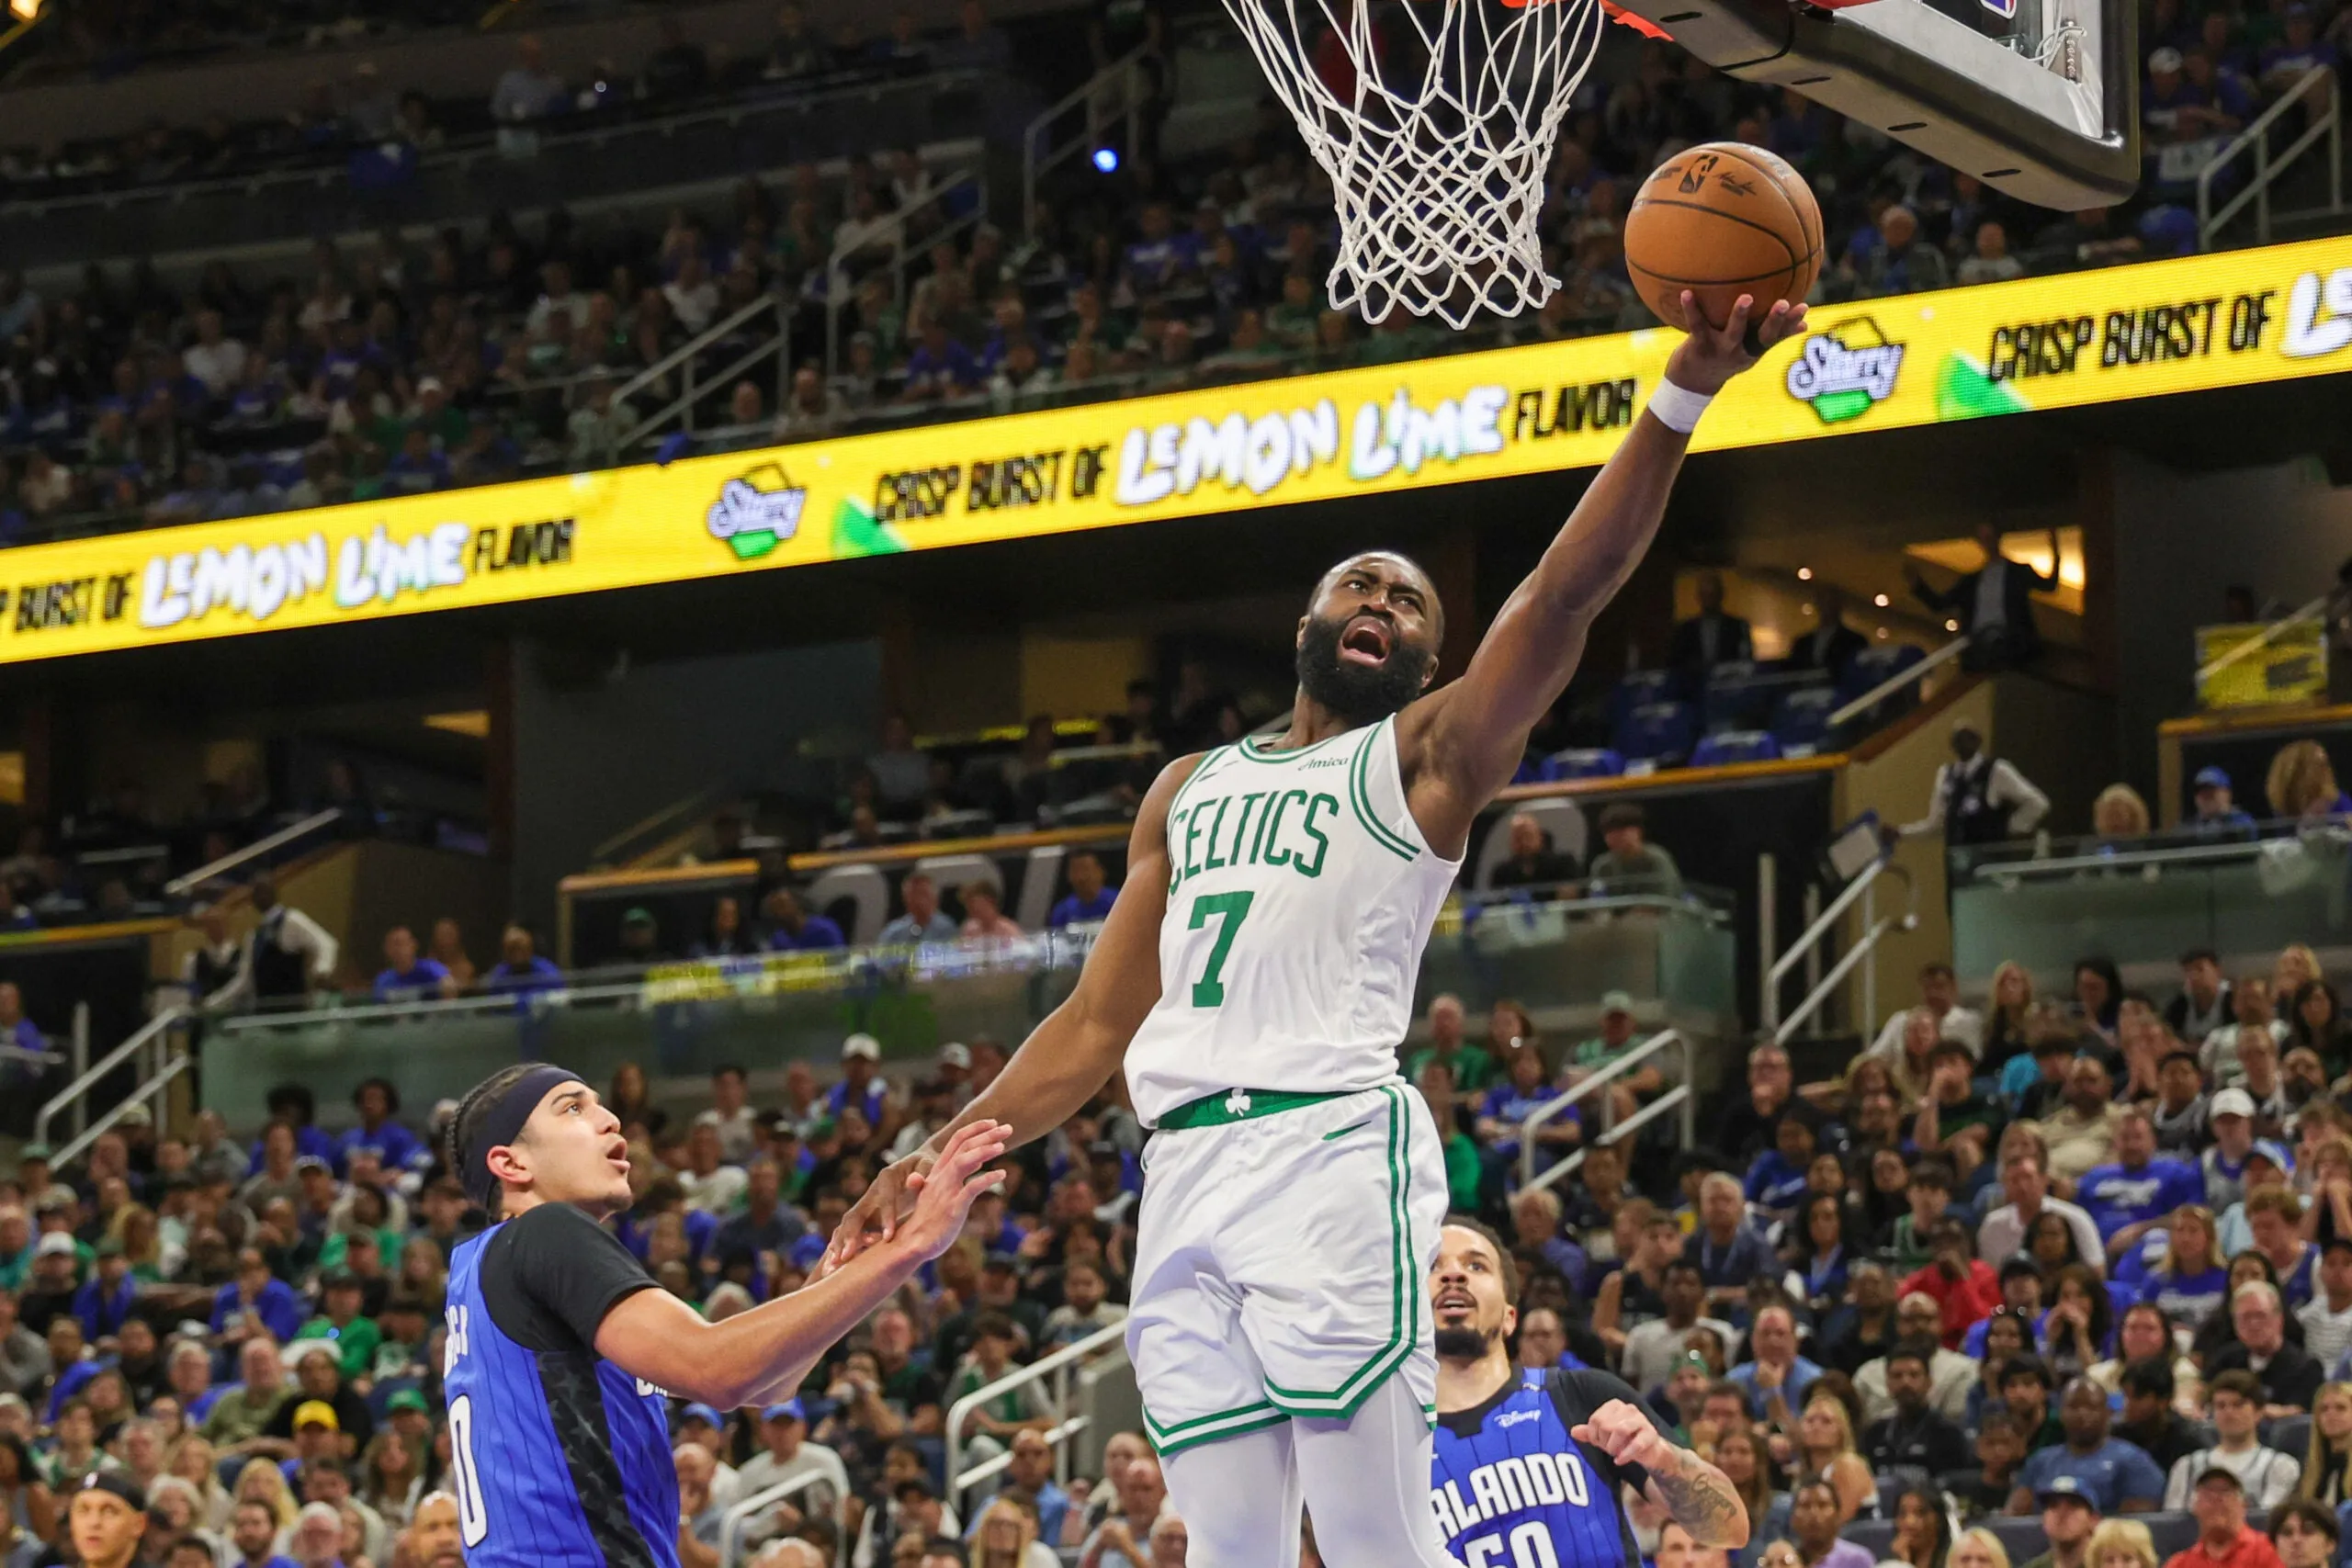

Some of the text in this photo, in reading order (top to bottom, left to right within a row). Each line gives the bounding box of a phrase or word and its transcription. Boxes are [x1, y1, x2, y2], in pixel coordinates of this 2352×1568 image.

[1990, 318, 2094, 380] CRISP
[2102, 298, 2222, 367] BURST
[2231, 291, 2275, 351] OF
[876, 464, 961, 523] CRISP
[967, 449, 1067, 512] BURST
[1072, 443, 1110, 499] OF
[1115, 398, 1339, 506] LEMON
[1513, 377, 1637, 443] FLAVOR
[140, 531, 329, 628] LEMON
[474, 518, 574, 576] FLAVOR
[1297, 756, 1350, 772] Amica
[1169, 789, 1340, 897] CELTICS
[1187, 890, 1255, 1009] 7
[447, 1393, 490, 1550] 0
[1493, 1408, 1542, 1428] Disney
[1430, 1451, 1589, 1544] RLANDO
